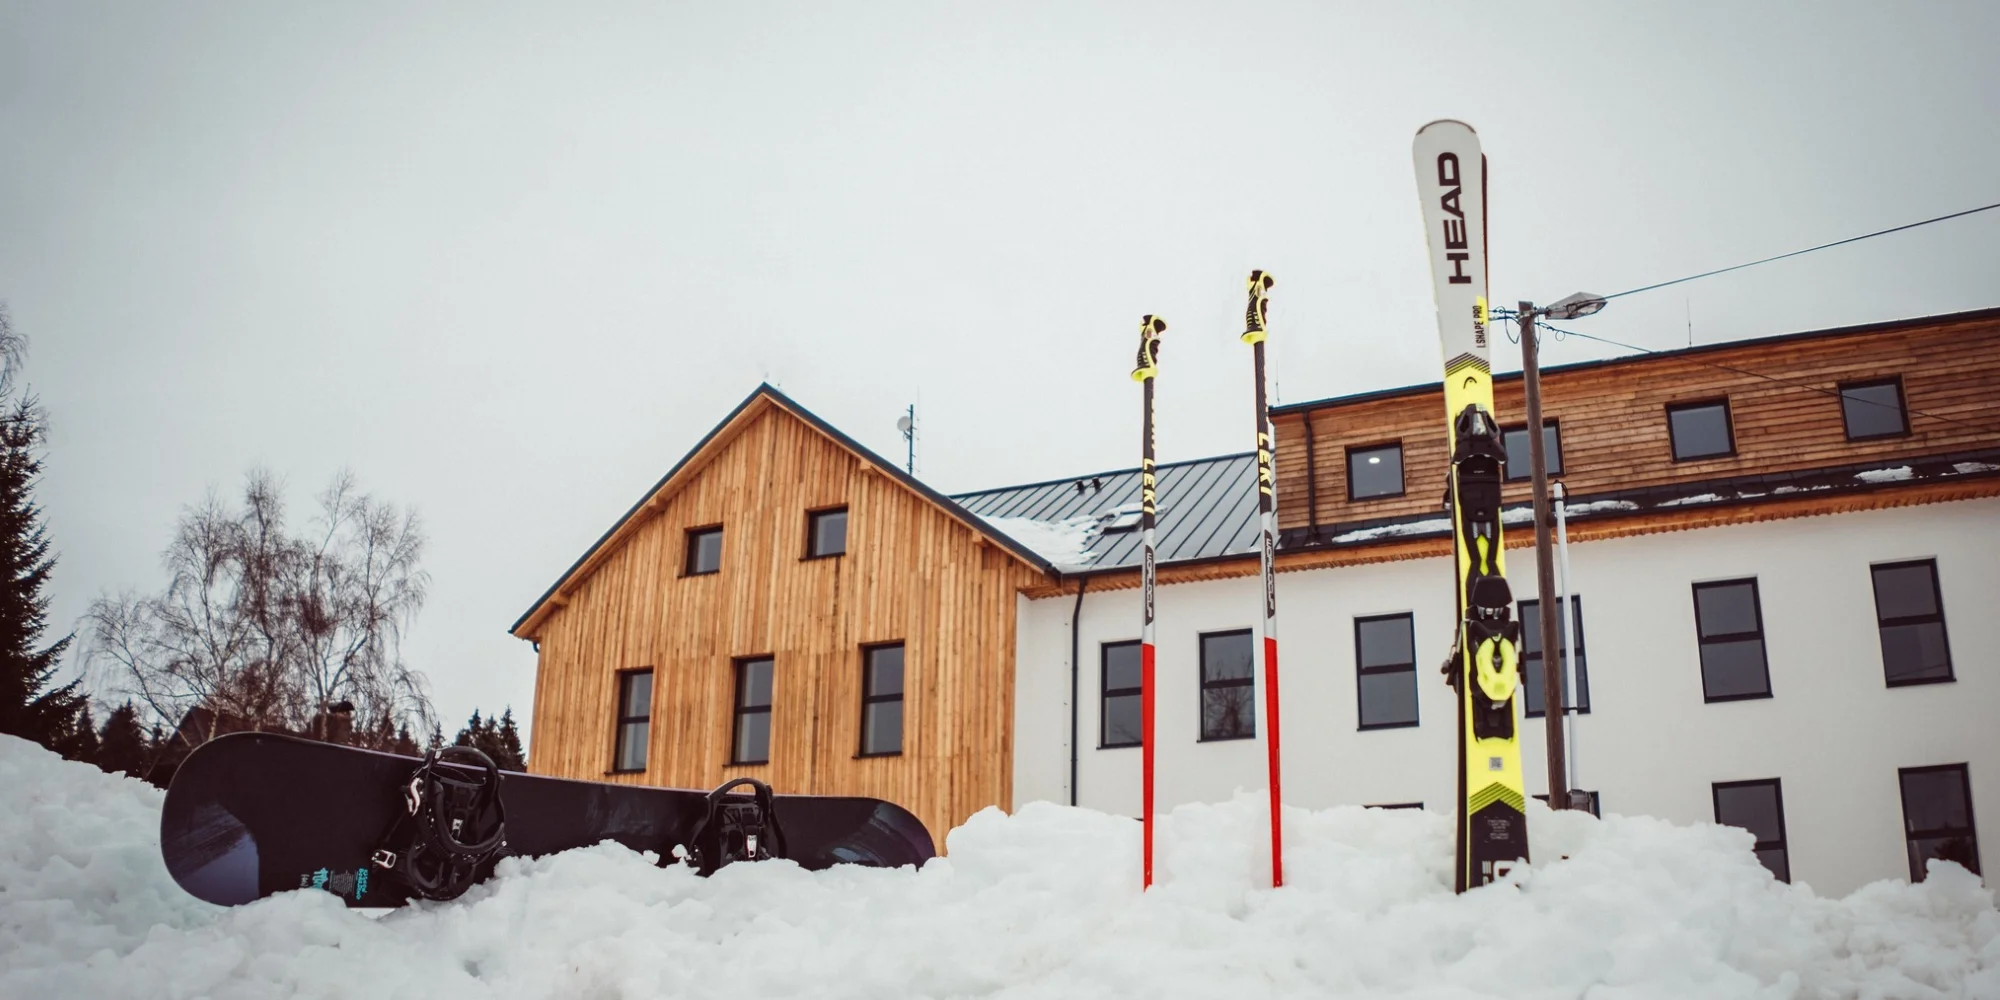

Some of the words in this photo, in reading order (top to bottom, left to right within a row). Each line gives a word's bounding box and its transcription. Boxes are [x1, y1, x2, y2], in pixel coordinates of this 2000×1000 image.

[1438, 152, 1472, 284] HEAD
[1473, 306, 1483, 318] PRO
[1144, 458, 1155, 515] LEKI
[1258, 432, 1272, 496] LEKI
[1266, 538, 1275, 611] WORLDCUP
